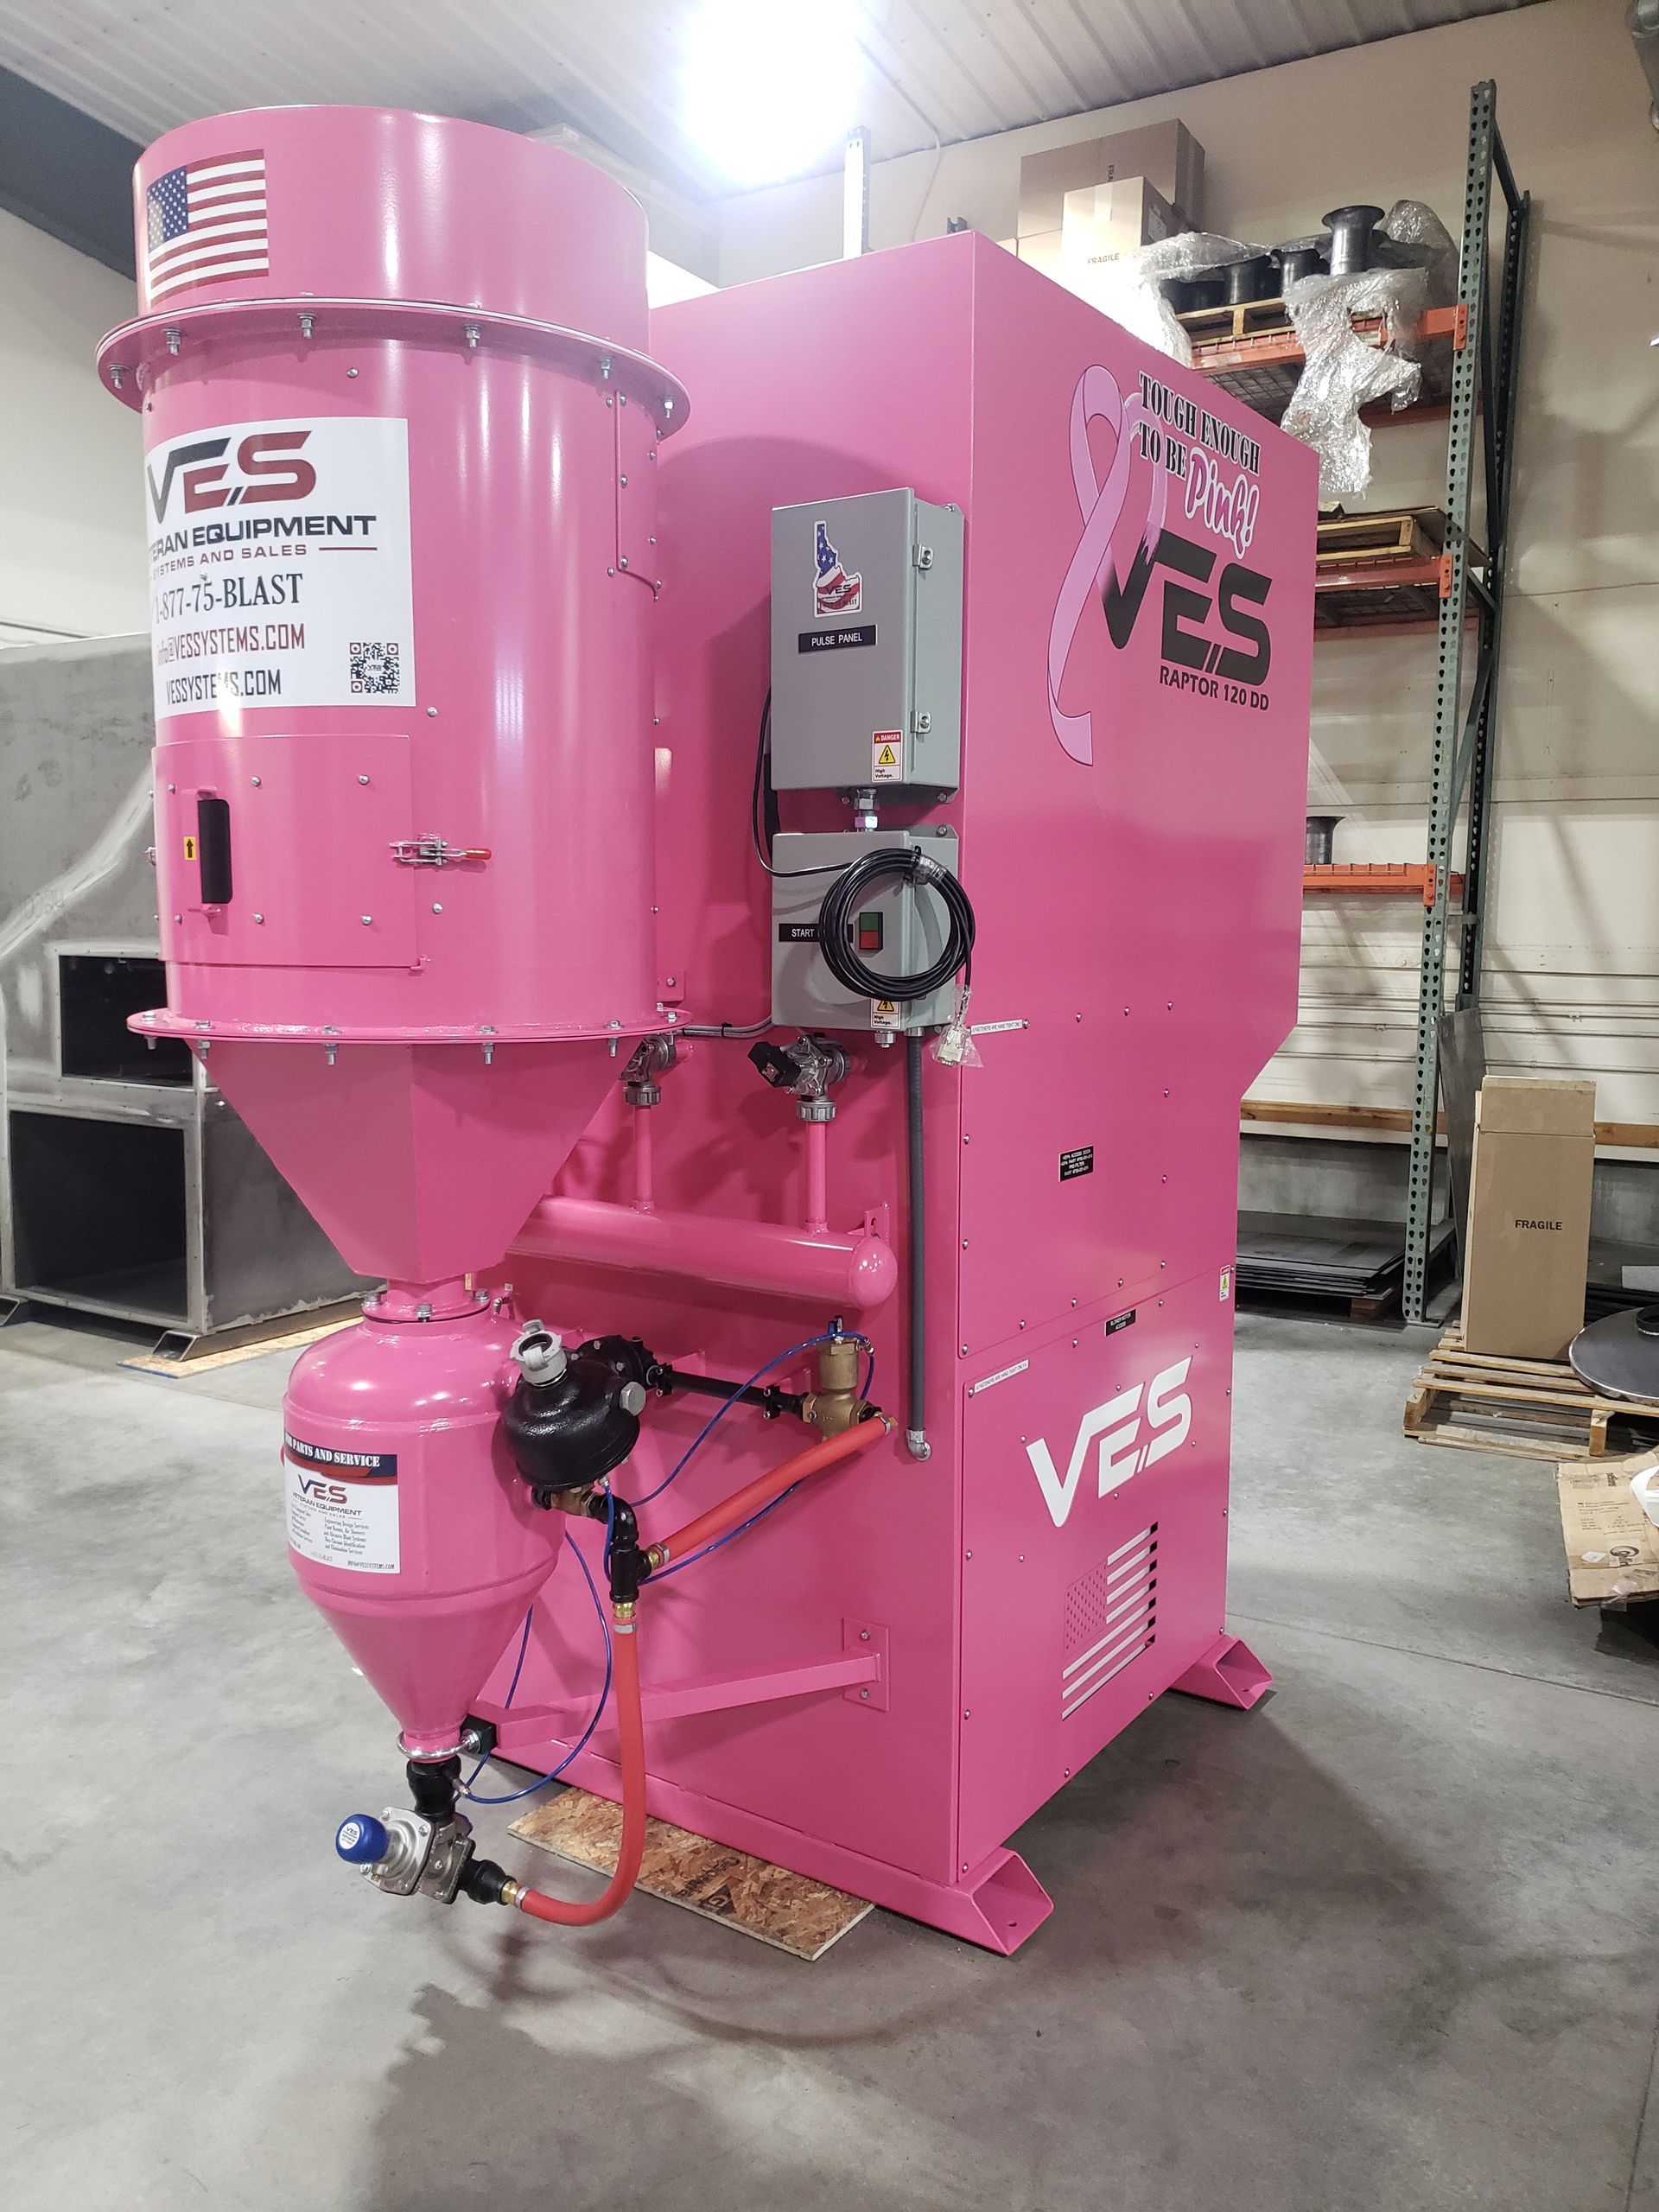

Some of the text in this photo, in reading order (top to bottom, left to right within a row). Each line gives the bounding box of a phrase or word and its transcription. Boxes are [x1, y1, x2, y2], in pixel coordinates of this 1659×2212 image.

[1088, 252, 1120, 264] FRAGILE
[1140, 372, 1260, 474] TOUGH ENOUGH
[1140, 423, 1186, 477] TO BE
[147, 430, 316, 524] VES
[1184, 448, 1259, 559] Pink!
[193, 516, 377, 547] EQUIPMENT
[200, 548, 233, 564] AND
[241, 543, 308, 559] SALES
[156, 573, 302, 624] 1-877-75-BLAST
[1099, 528, 1272, 685] VES
[810, 632, 862, 647] PULSE PANEL
[1160, 665, 1269, 711] RAPTOR 120 DD
[791, 928, 815, 938] START
[1515, 1219, 1563, 1230] FRAGILE
[293, 1438, 313, 1457] PARTS
[315, 1447, 332, 1462] AND
[334, 1452, 380, 1468] SERVICE
[1026, 1356, 1192, 1528] VES
[297, 1474, 347, 1503] VES
[315, 1502, 362, 1516] EQUIPMENT
